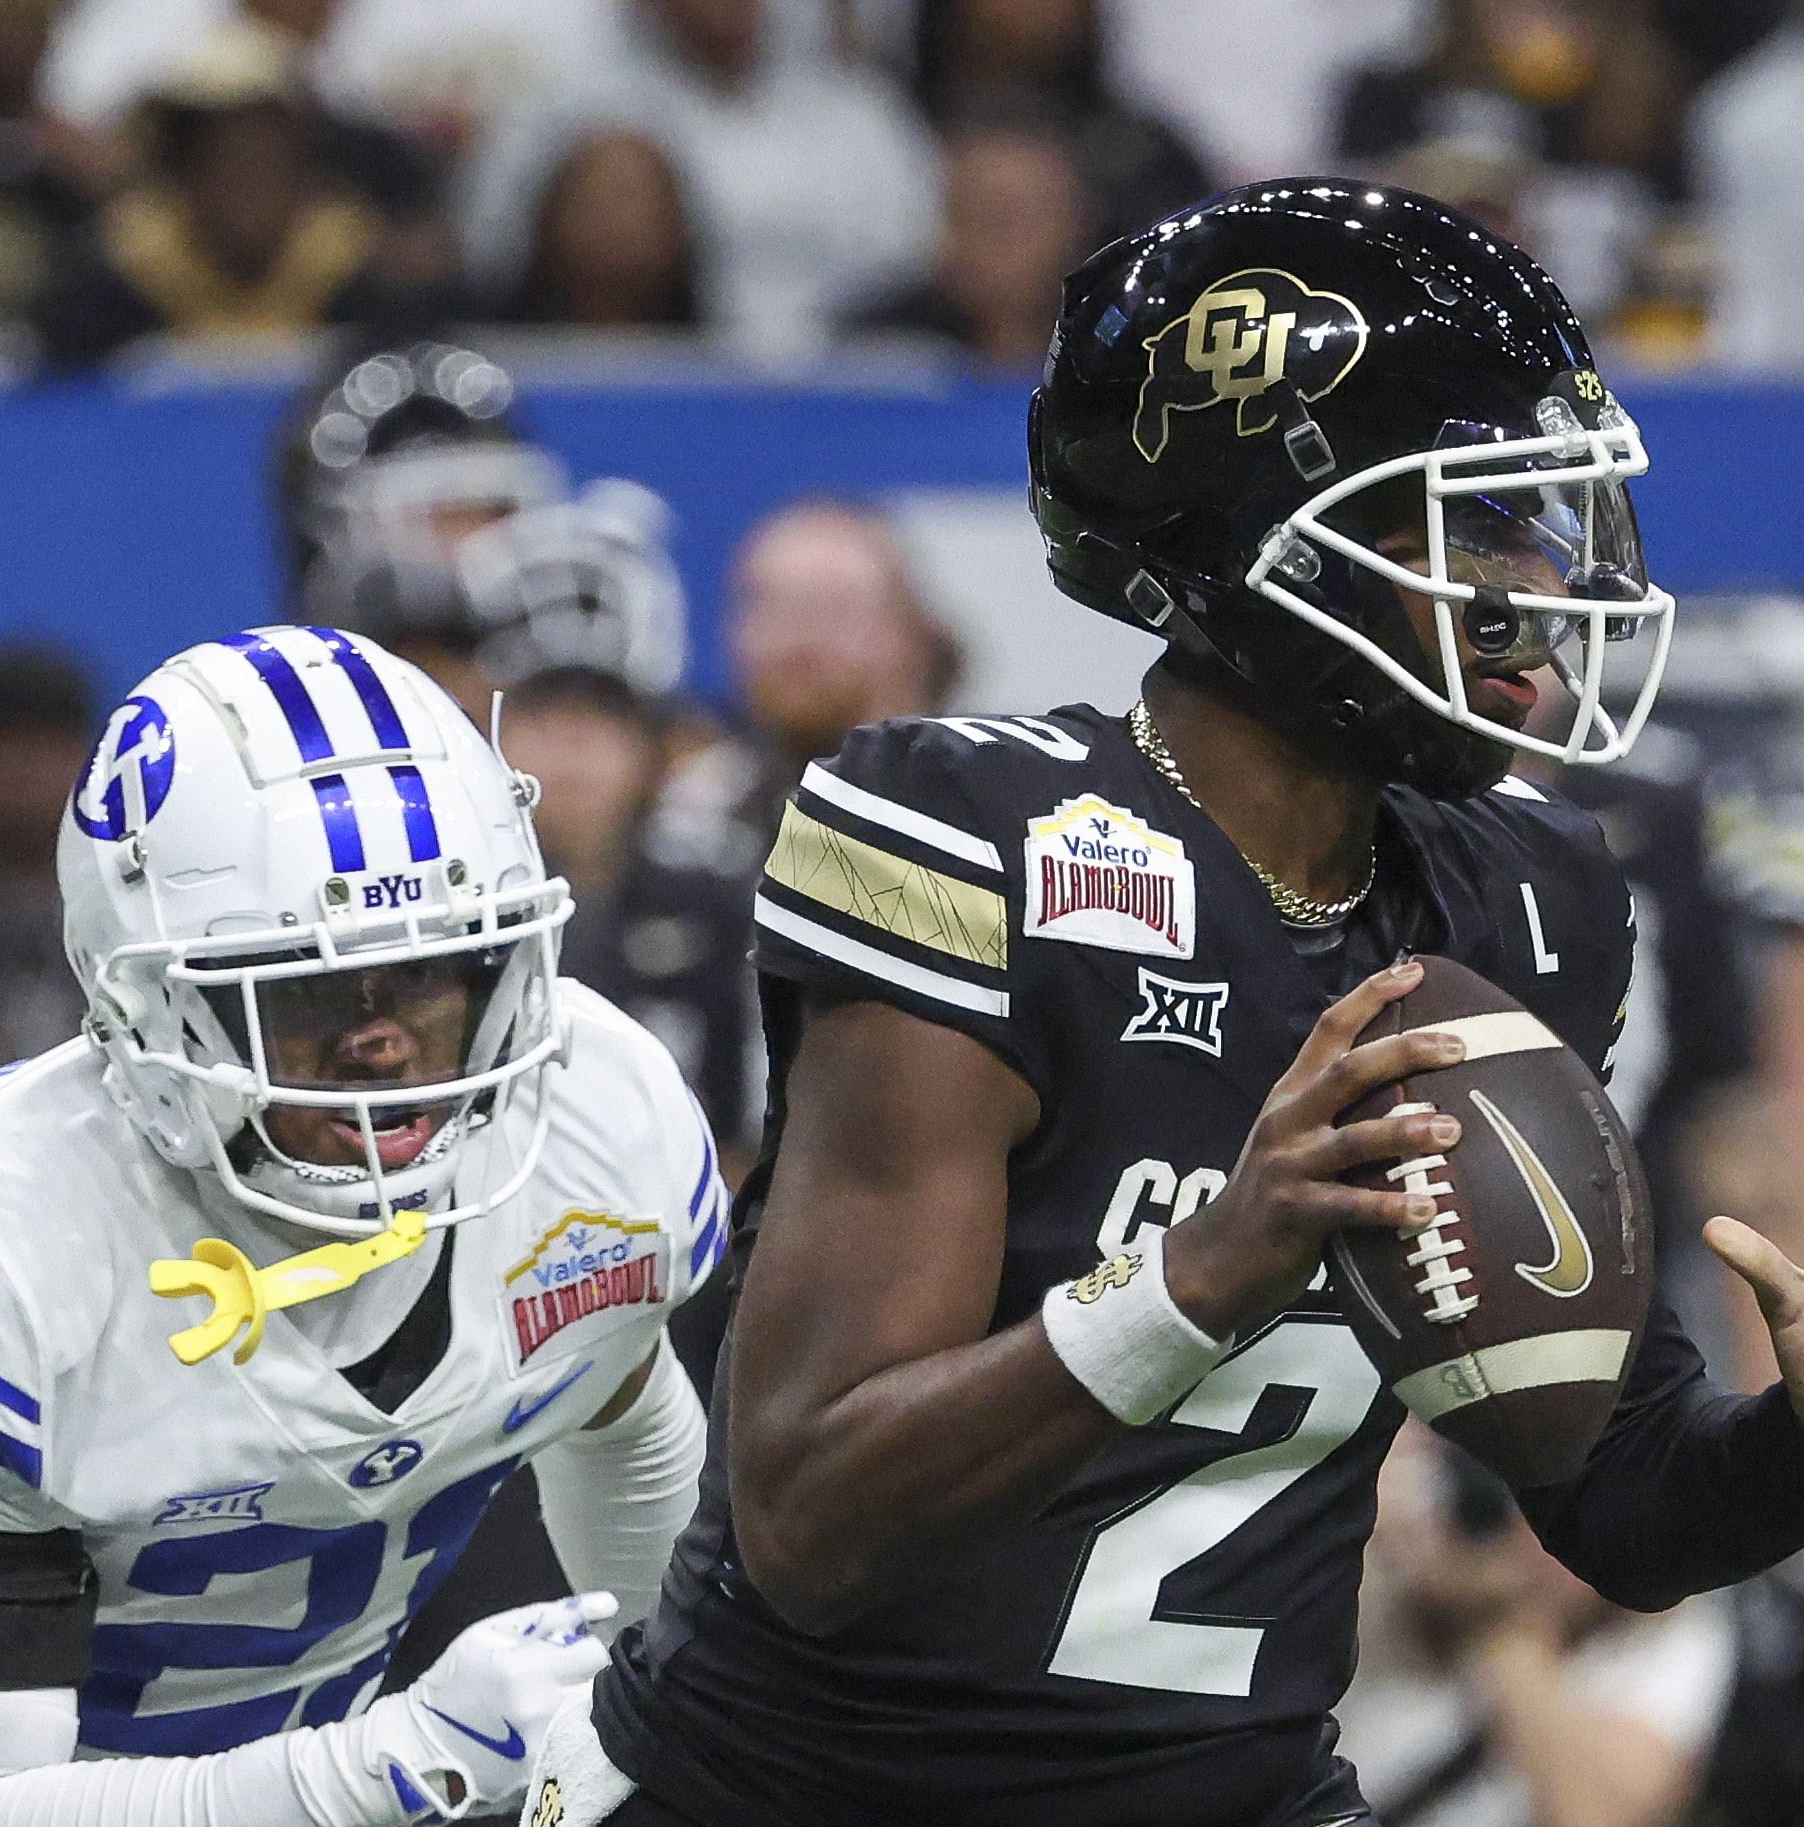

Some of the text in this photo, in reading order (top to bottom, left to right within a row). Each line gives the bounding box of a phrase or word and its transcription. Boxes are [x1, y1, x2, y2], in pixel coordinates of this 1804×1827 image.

[1185, 288, 1296, 399] CU
[1575, 371, 1603, 400] S2S
[1061, 834, 1149, 867] Valero
[362, 874, 422, 908] BYU
[1519, 882, 1559, 974] L
[531, 1242, 629, 1287] Valero
[1047, 1322, 1382, 1697] 2
